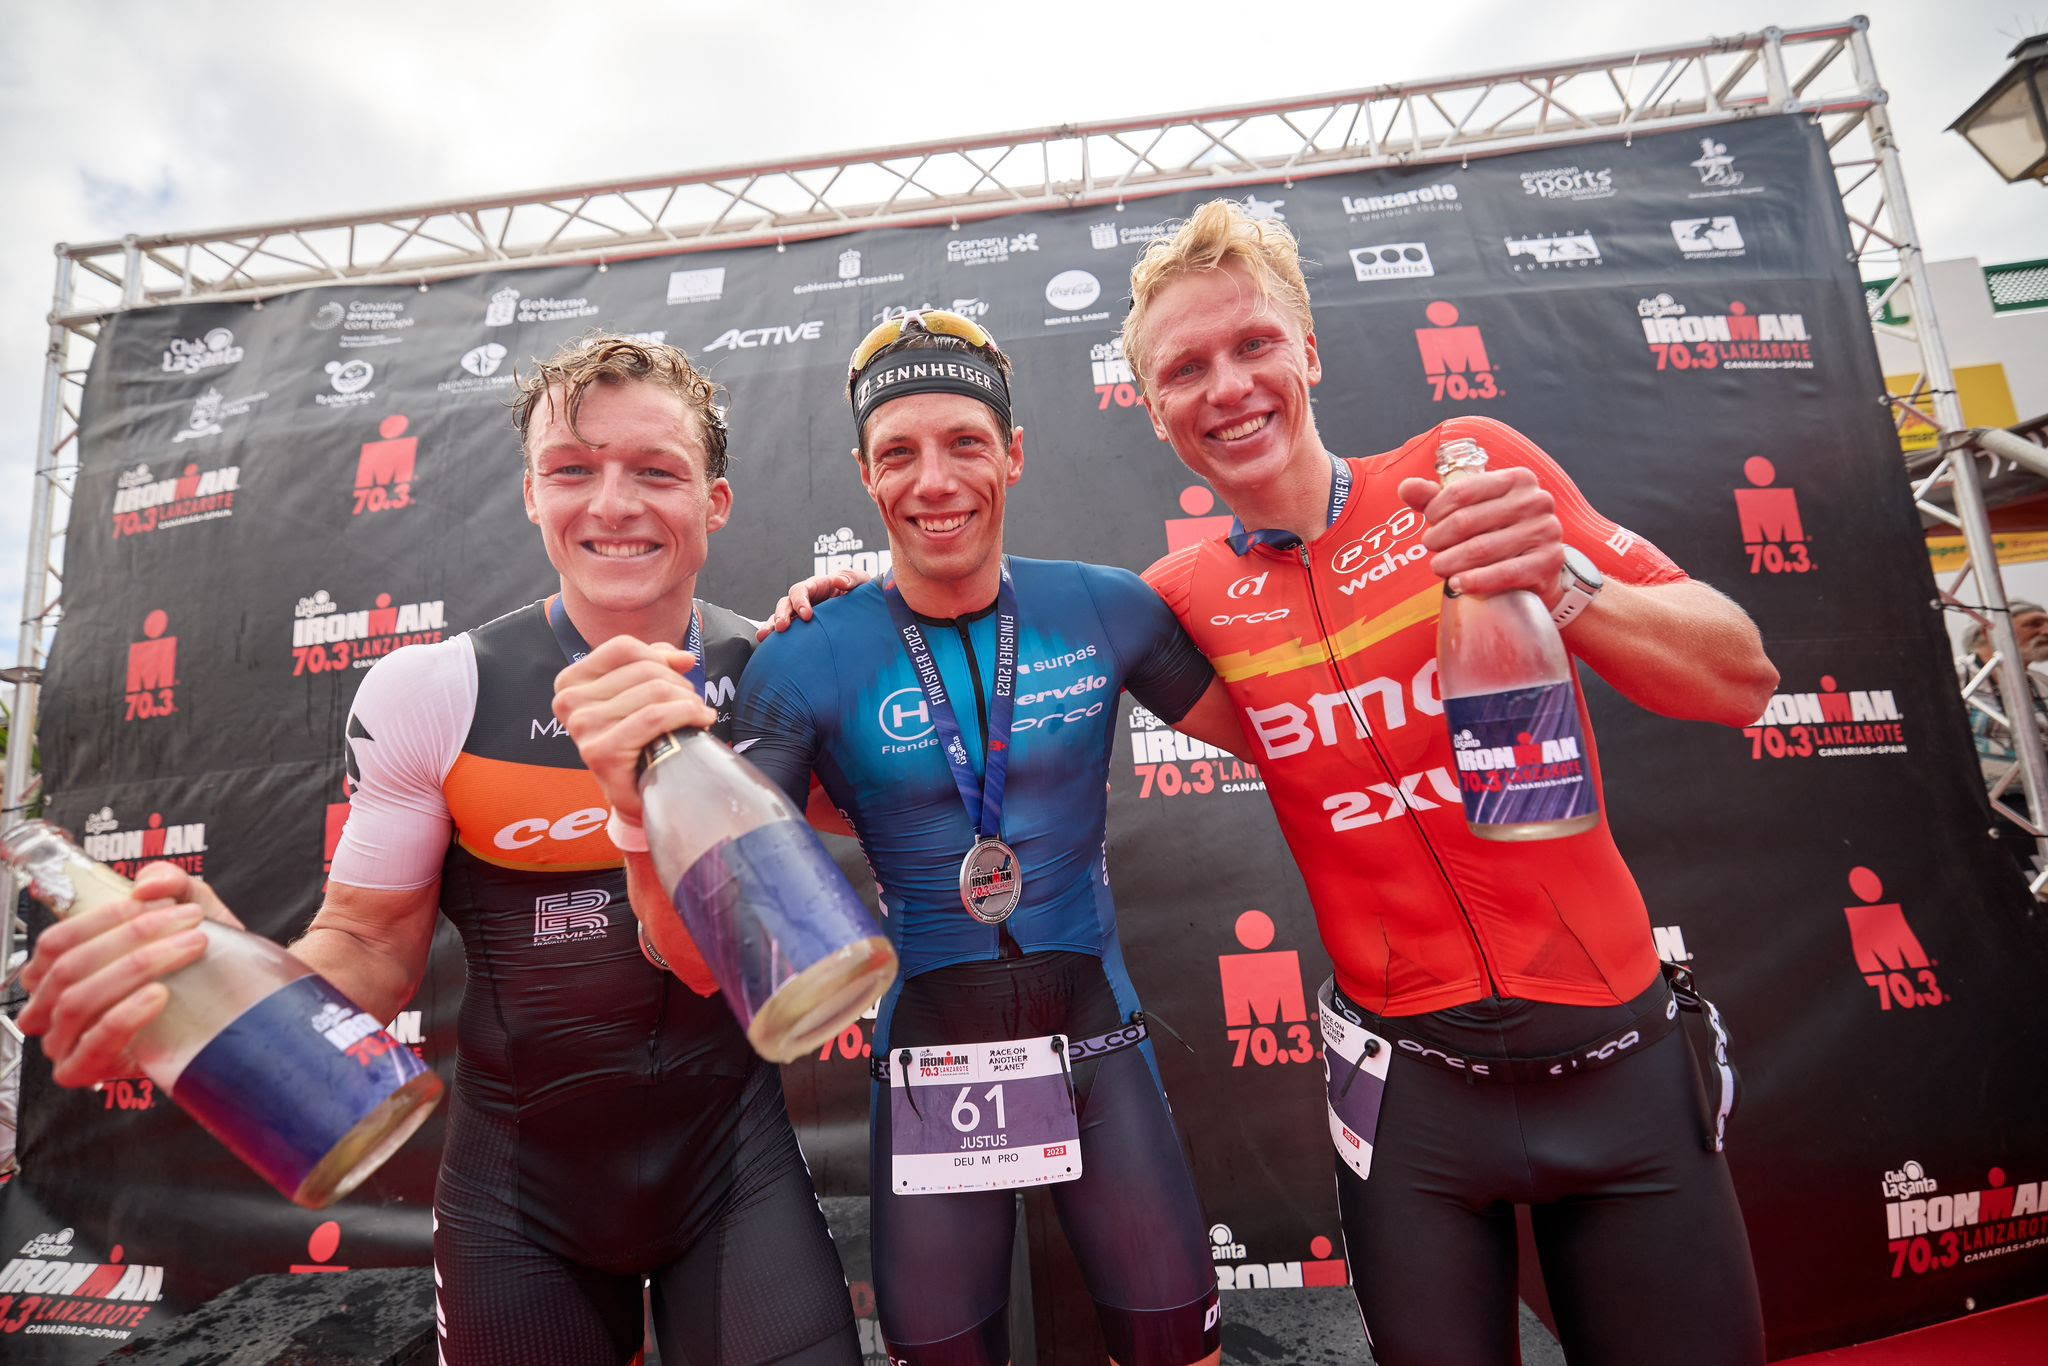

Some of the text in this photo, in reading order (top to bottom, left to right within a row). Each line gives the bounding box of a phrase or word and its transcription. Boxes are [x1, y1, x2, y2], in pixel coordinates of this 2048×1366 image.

[1522, 168, 1612, 197] sports
[1342, 184, 1458, 214] Lanzarote
[947, 236, 1008, 251] Canary
[947, 247, 1008, 262] Islands
[794, 273, 905, 294] Gobierno de Canarias
[1361, 265, 1429, 276] SECURITAS
[518, 305, 599, 321] de Canarias
[520, 298, 587, 310] Gobierno
[702, 321, 824, 352] ACTIVE
[1642, 313, 1806, 343] IRONMAN
[1649, 343, 1812, 371] 70.3 LANZAROTE
[876, 364, 992, 390] SENNHEISER
[1427, 372, 1499, 401] 70.3
[352, 483, 411, 516] 70.3
[112, 506, 159, 539] 70.3
[1341, 511, 1416, 569] PTO
[1338, 543, 1428, 596] waho
[1745, 544, 1811, 574] 70.3
[293, 600, 445, 648] IRONMAN
[1210, 608, 1290, 627] orca
[291, 641, 350, 677] 70.3
[903, 625, 945, 706] FINISHER 2023
[996, 614, 1014, 697] FINISHER 2023
[1034, 645, 1097, 672] surpas
[125, 688, 174, 721] 70.3
[1014, 675, 1107, 706] ervélo
[1011, 702, 1104, 732] orca
[882, 738, 939, 754] Flende
[1456, 736, 1581, 771] IRONMAN
[1743, 724, 1904, 760] 70.3 LANZAROTE
[1135, 761, 1215, 798] 70.3
[1461, 769, 1503, 793] 70.3
[972, 871, 1012, 887] IRONMAN
[534, 928, 606, 943] RAMPA
[1864, 970, 1943, 1010] 70.3
[988, 1055, 1028, 1065] ANOTHER
[990, 1047, 1026, 1057] RACE ON
[1227, 1024, 1314, 1067] 70.3
[920, 1055, 969, 1067] IRONMAN
[920, 1067, 939, 1077] 70.3
[993, 1063, 1025, 1072] PLANET
[103, 1080, 153, 1110] 70.3
[951, 1084, 1006, 1133] 61
[960, 1134, 1008, 1150] JUSTUS
[1046, 1147, 1065, 1157] 2023
[954, 1153, 1019, 1167] DEU M PRO
[1885, 1170, 1907, 1183] Club
[35, 1232, 56, 1245] Club
[1211, 1242, 1248, 1260] anta
[1889, 1215, 2048, 1278] 70.3 LANZAROT
[0, 1258, 164, 1303] IRONMAN
[37, 1298, 152, 1328] LANZAROTE
